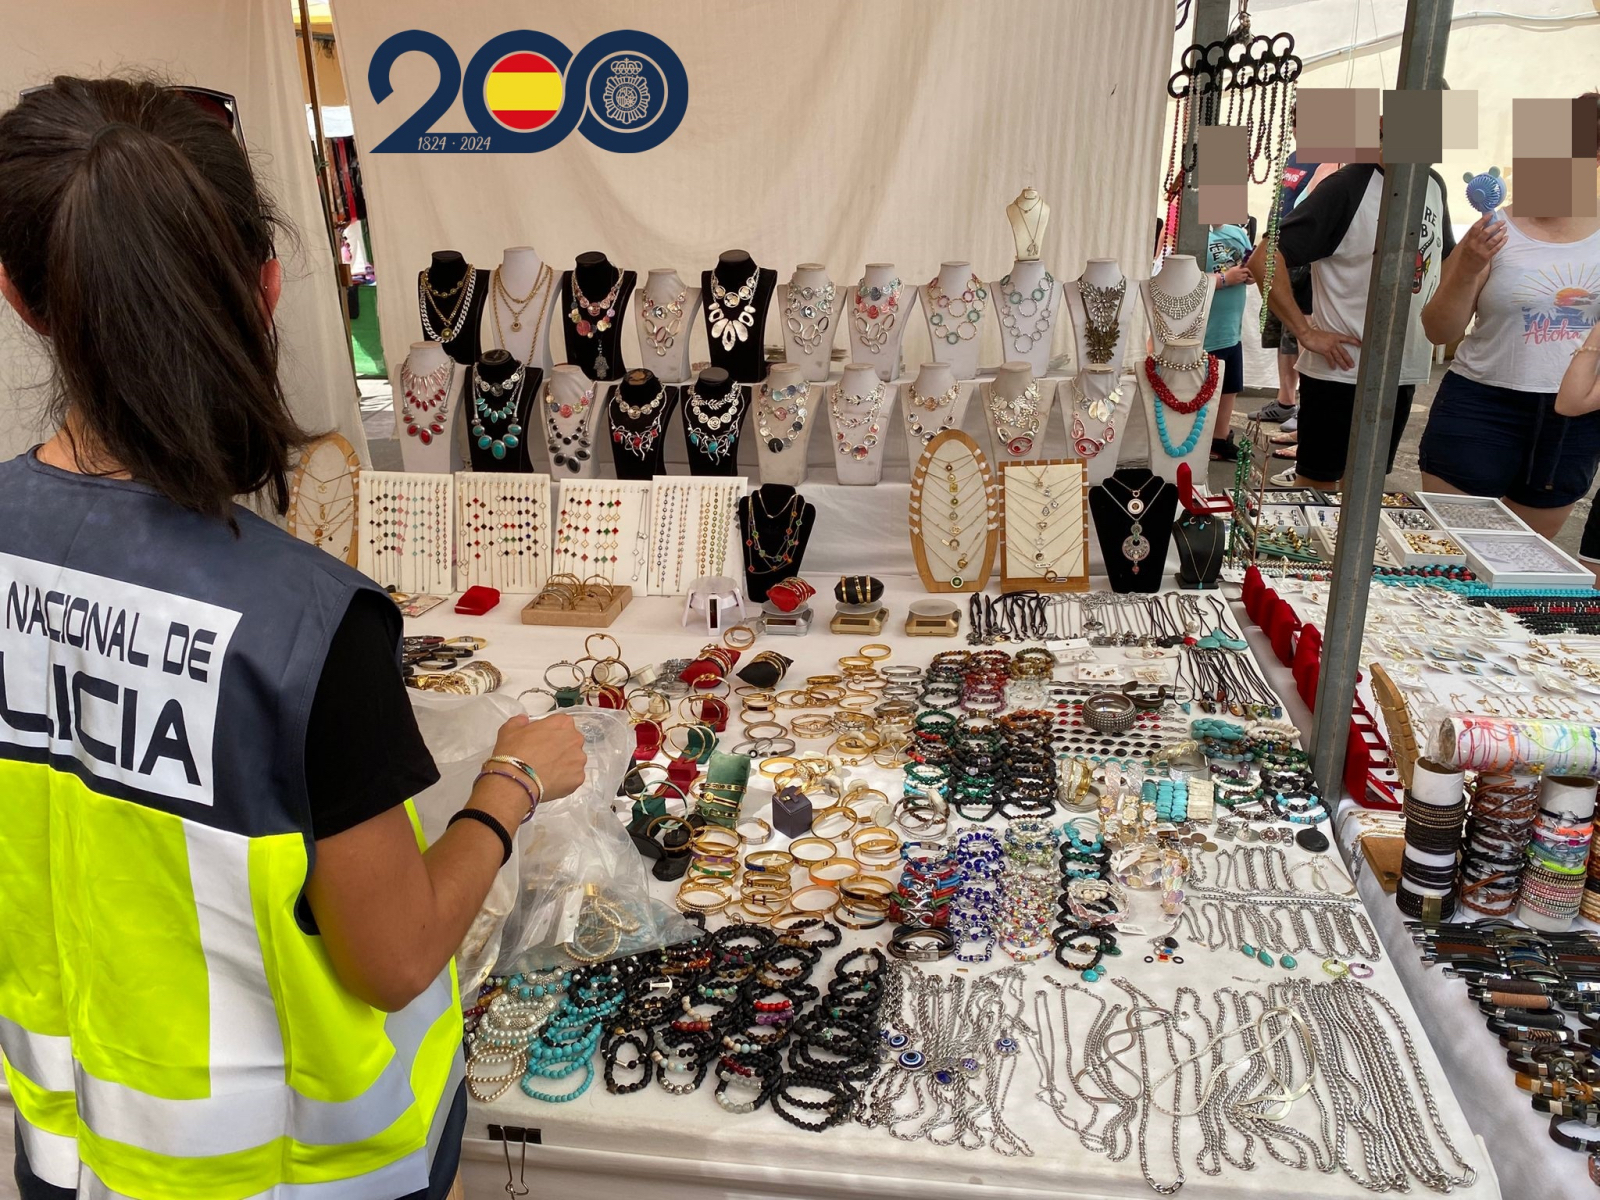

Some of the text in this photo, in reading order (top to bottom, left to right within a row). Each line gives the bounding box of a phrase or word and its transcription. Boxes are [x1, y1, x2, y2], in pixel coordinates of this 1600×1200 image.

[1522, 318, 1580, 345] Aloha
[6, 580, 218, 683] NACIONAL DE
